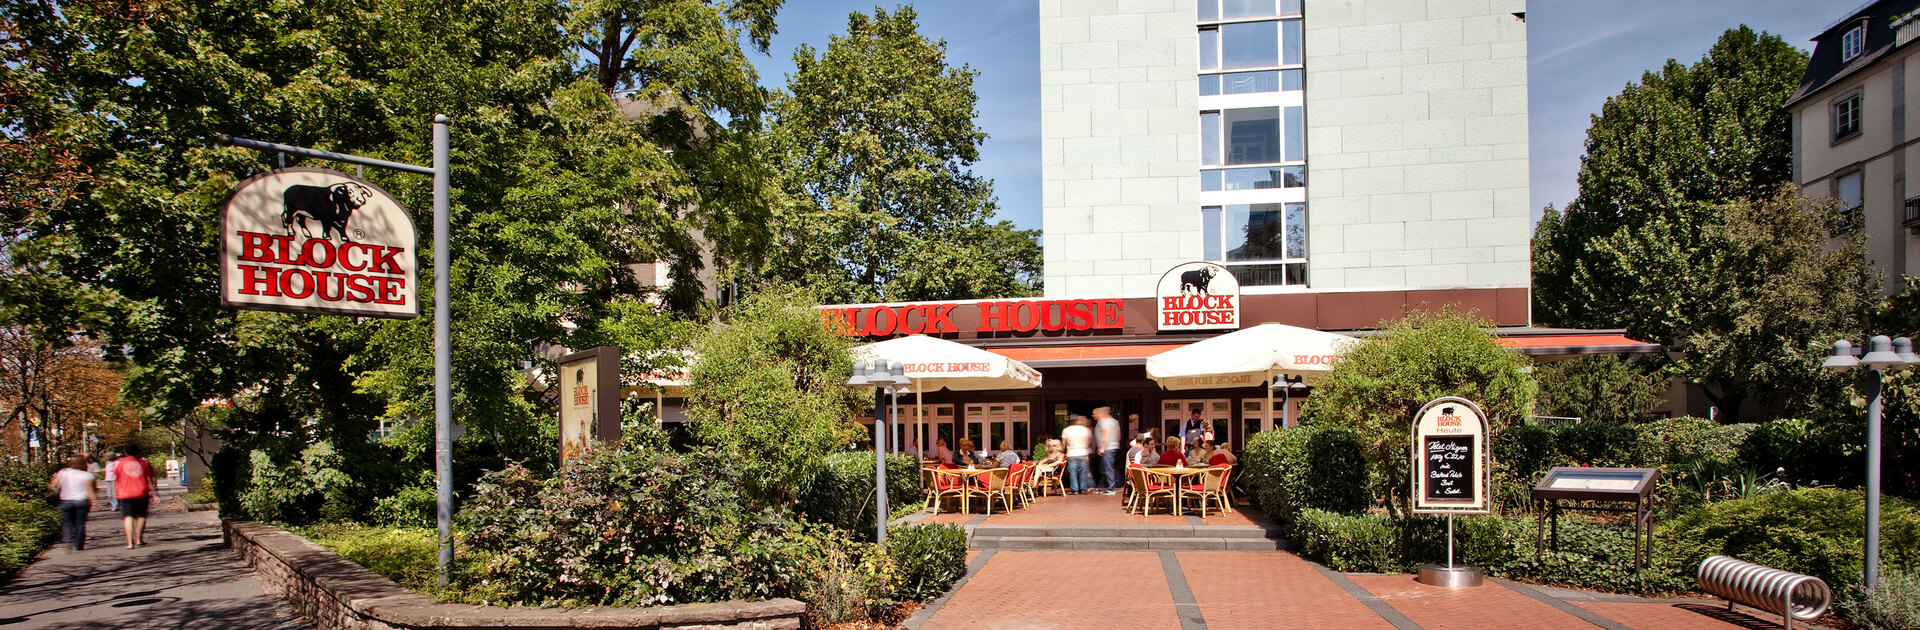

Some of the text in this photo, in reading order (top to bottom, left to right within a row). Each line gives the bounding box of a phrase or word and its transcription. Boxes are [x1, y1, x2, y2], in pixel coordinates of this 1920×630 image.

[237, 231, 405, 275] BLOCK
[238, 265, 406, 306] HOUSE
[1162, 294, 1234, 310] BLOCK
[976, 298, 1124, 333] HOUSE
[1162, 310, 1234, 326] HOUSE
[903, 362, 990, 373] BLOCK HOUSE
[573, 395, 589, 406] HOUSE
